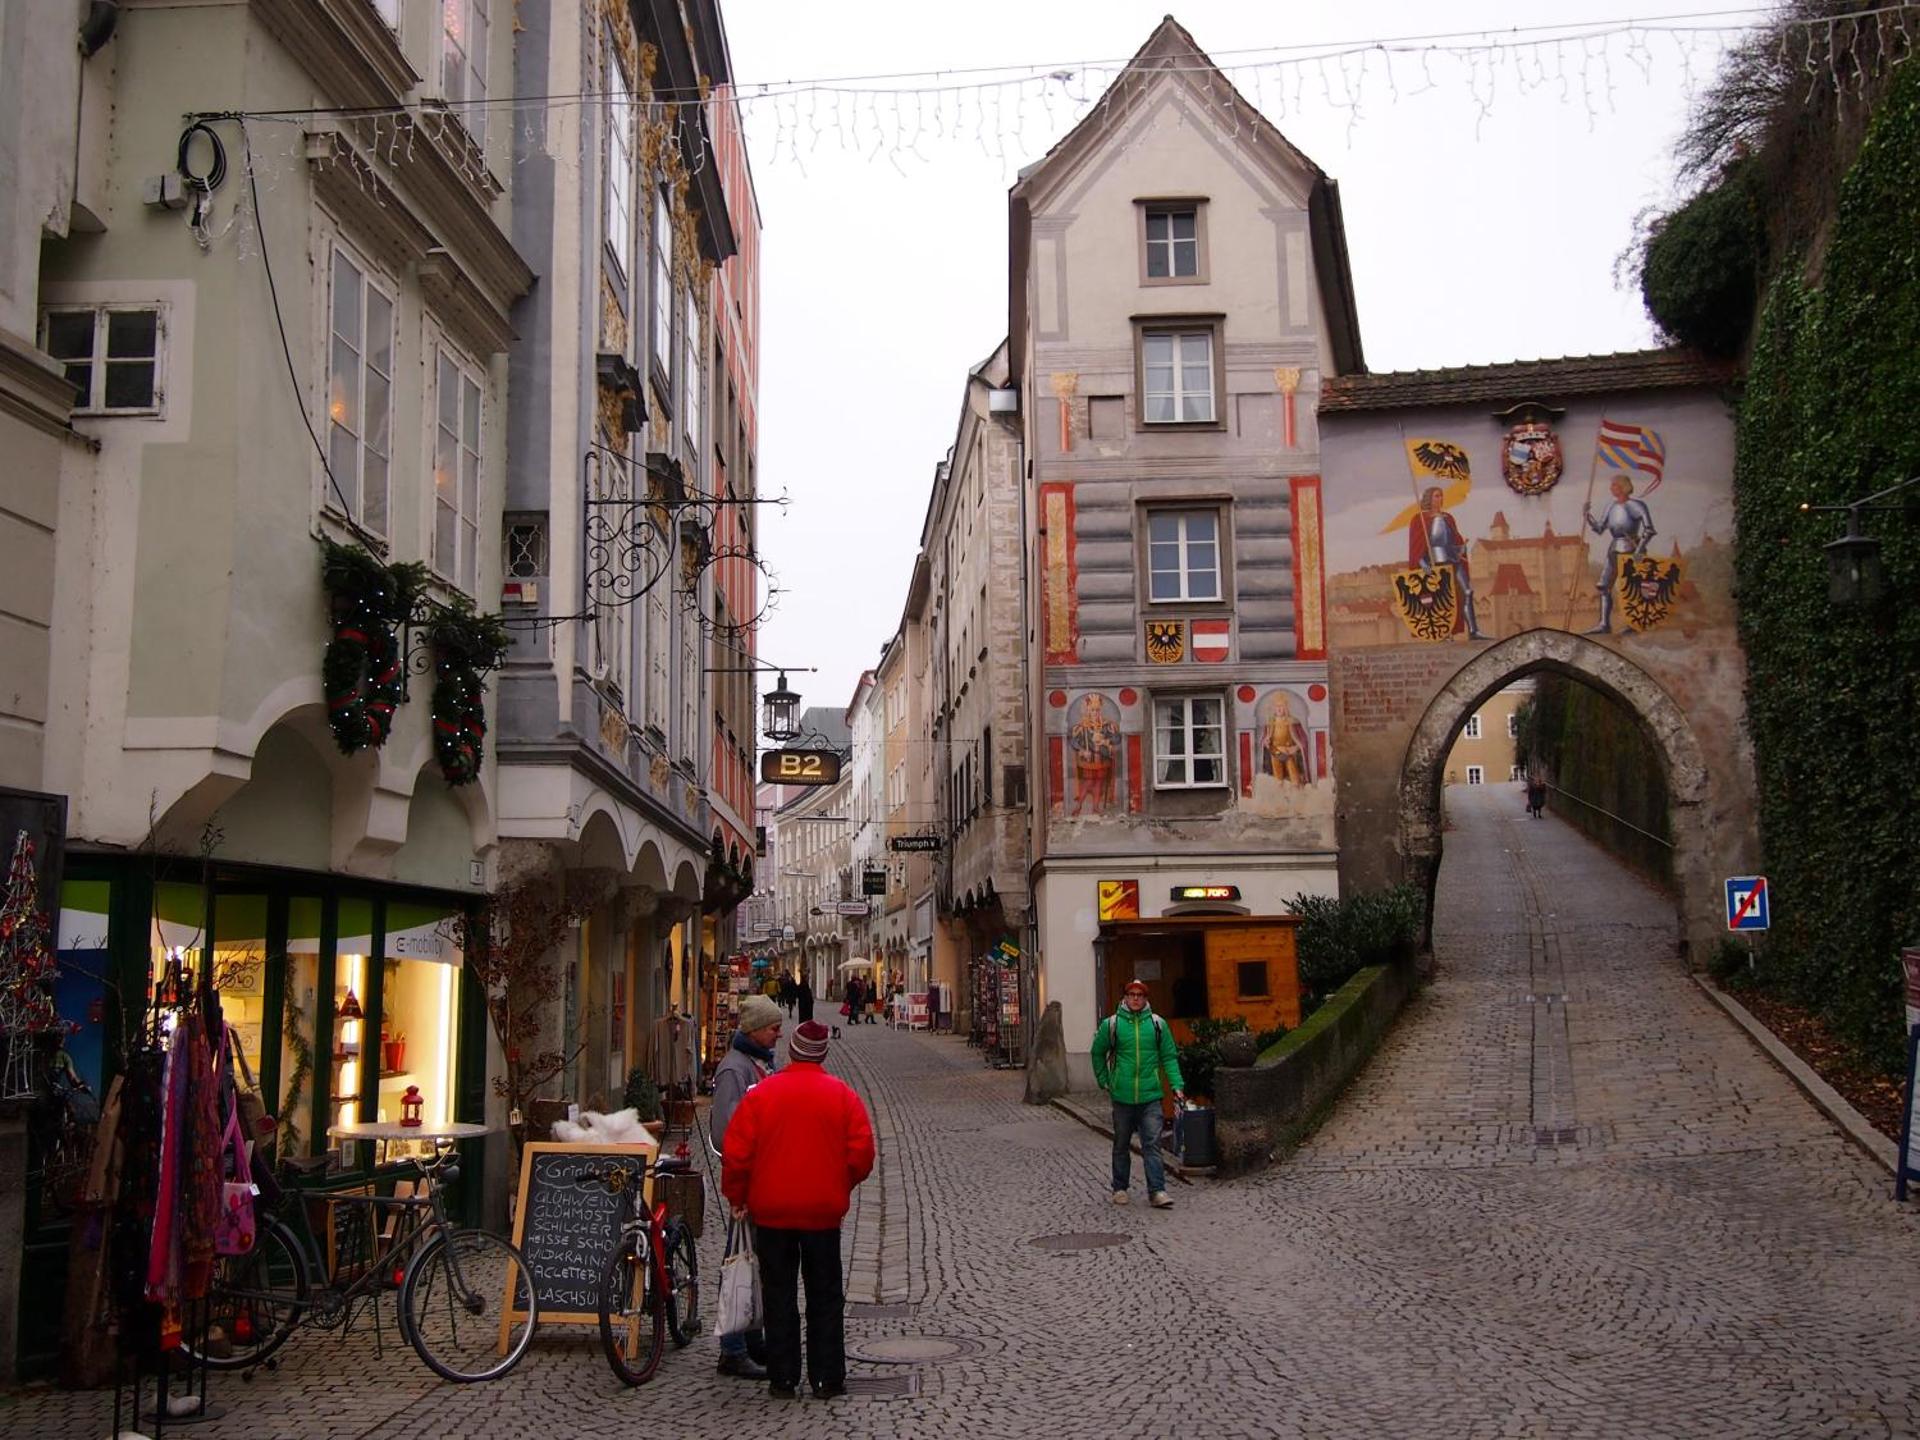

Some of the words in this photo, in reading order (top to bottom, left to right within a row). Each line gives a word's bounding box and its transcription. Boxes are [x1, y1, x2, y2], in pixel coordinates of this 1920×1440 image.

[780, 754, 822, 775] B2
[896, 839, 929, 849] Triumph
[528, 1233, 570, 1246] HEISSE
